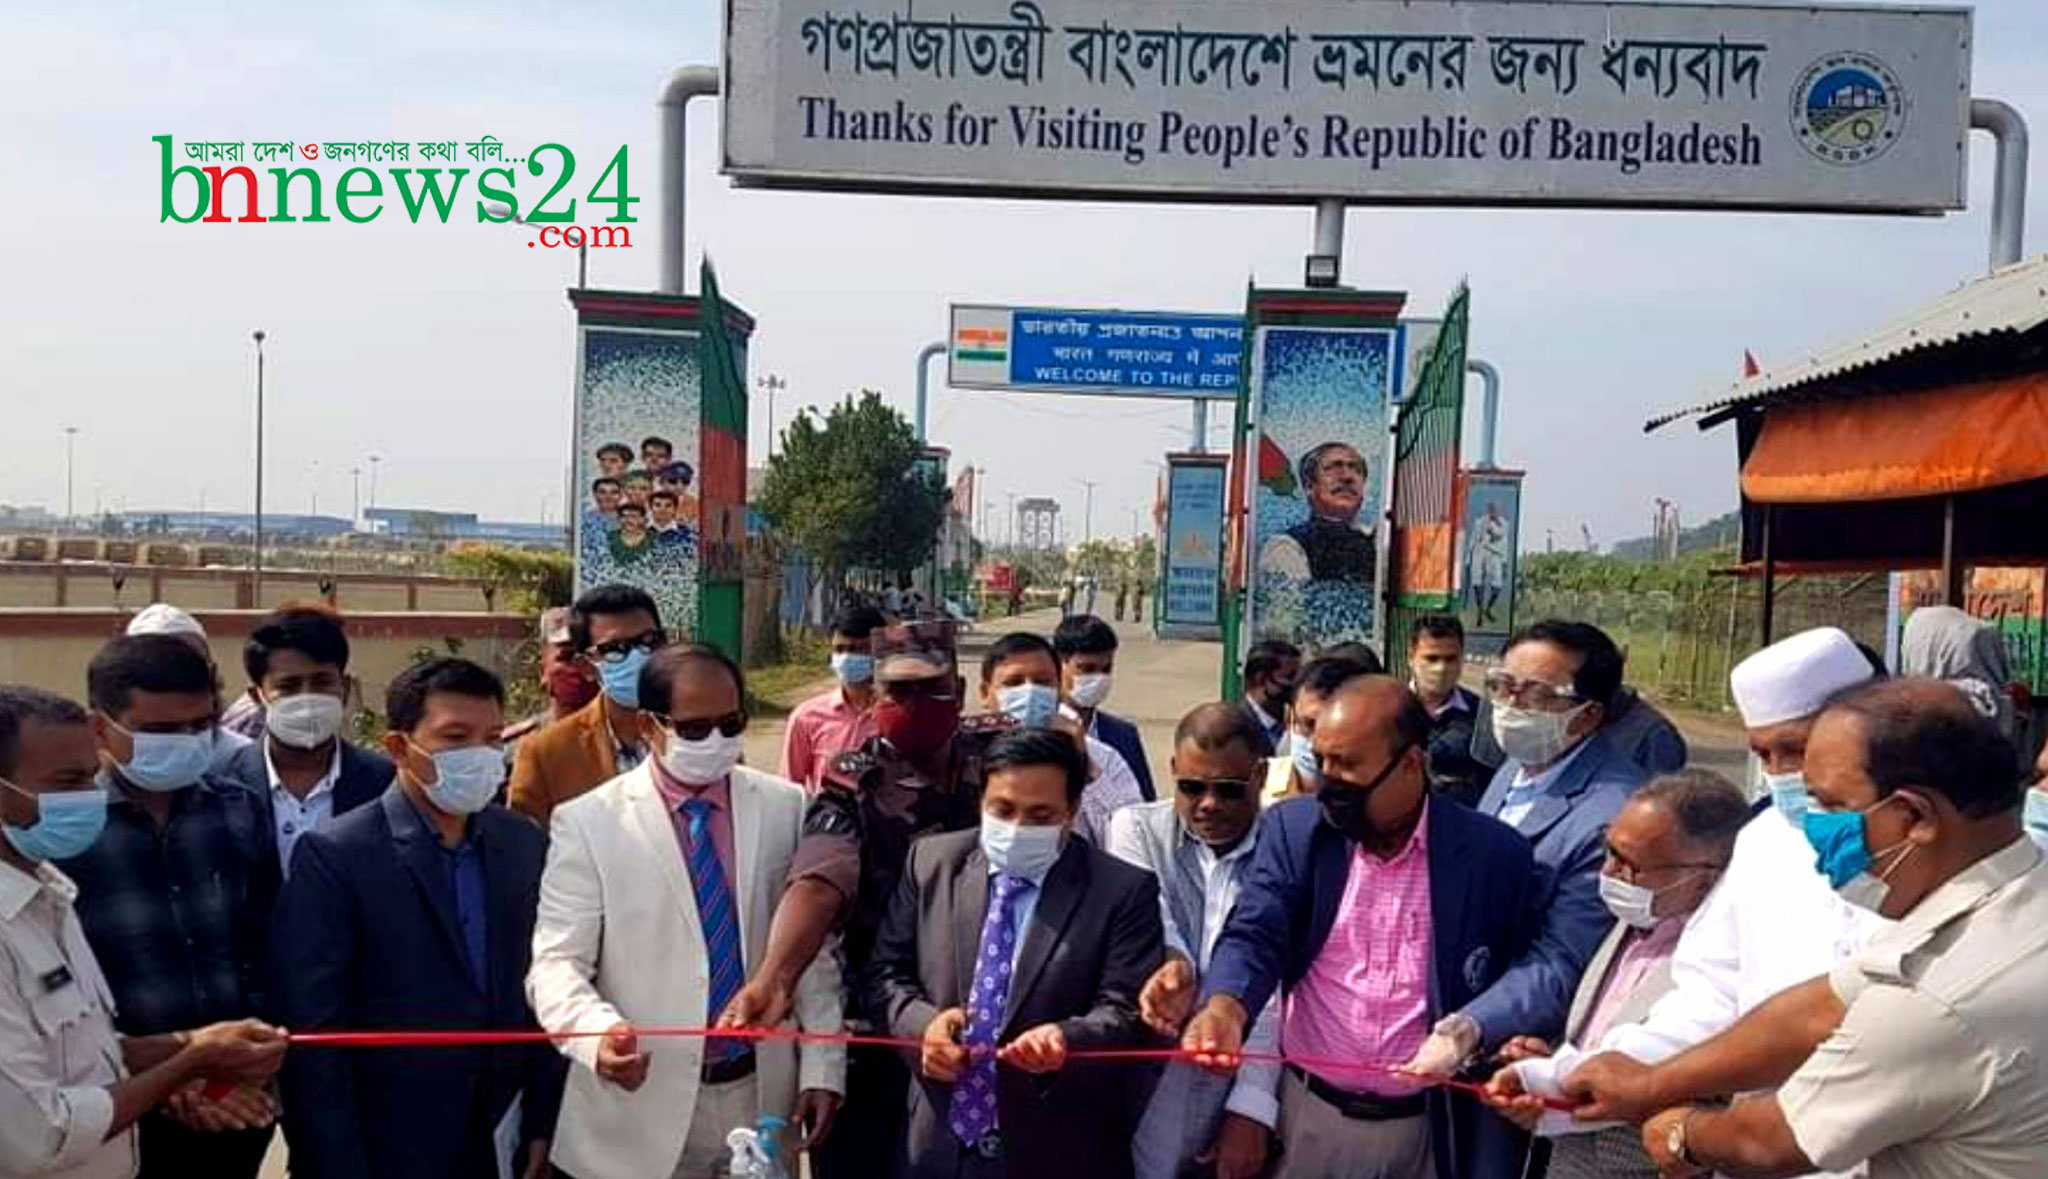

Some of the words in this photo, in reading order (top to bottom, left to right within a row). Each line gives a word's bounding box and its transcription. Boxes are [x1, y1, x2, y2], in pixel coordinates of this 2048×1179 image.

[801, 3, 1051, 86] গণপ্রজাতন্ত্রী
[1063, 20, 1299, 90] বাংলাদেশে
[1486, 36, 1586, 95] জন্য
[1601, 35, 1768, 100] ধন্যবাদ
[798, 96, 933, 143] Thanks
[946, 102, 999, 146] for
[1009, 105, 1146, 164] Visiting
[1322, 114, 1487, 170] Republic
[1499, 116, 1541, 161] of
[1547, 117, 1762, 174] Bangladesh
[1034, 366, 1123, 384] WELCOME
[1131, 370, 1154, 386] TO
[1160, 370, 1195, 387] THE
[1199, 372, 1242, 388] REP
[1211, 350, 1243, 367] आप
